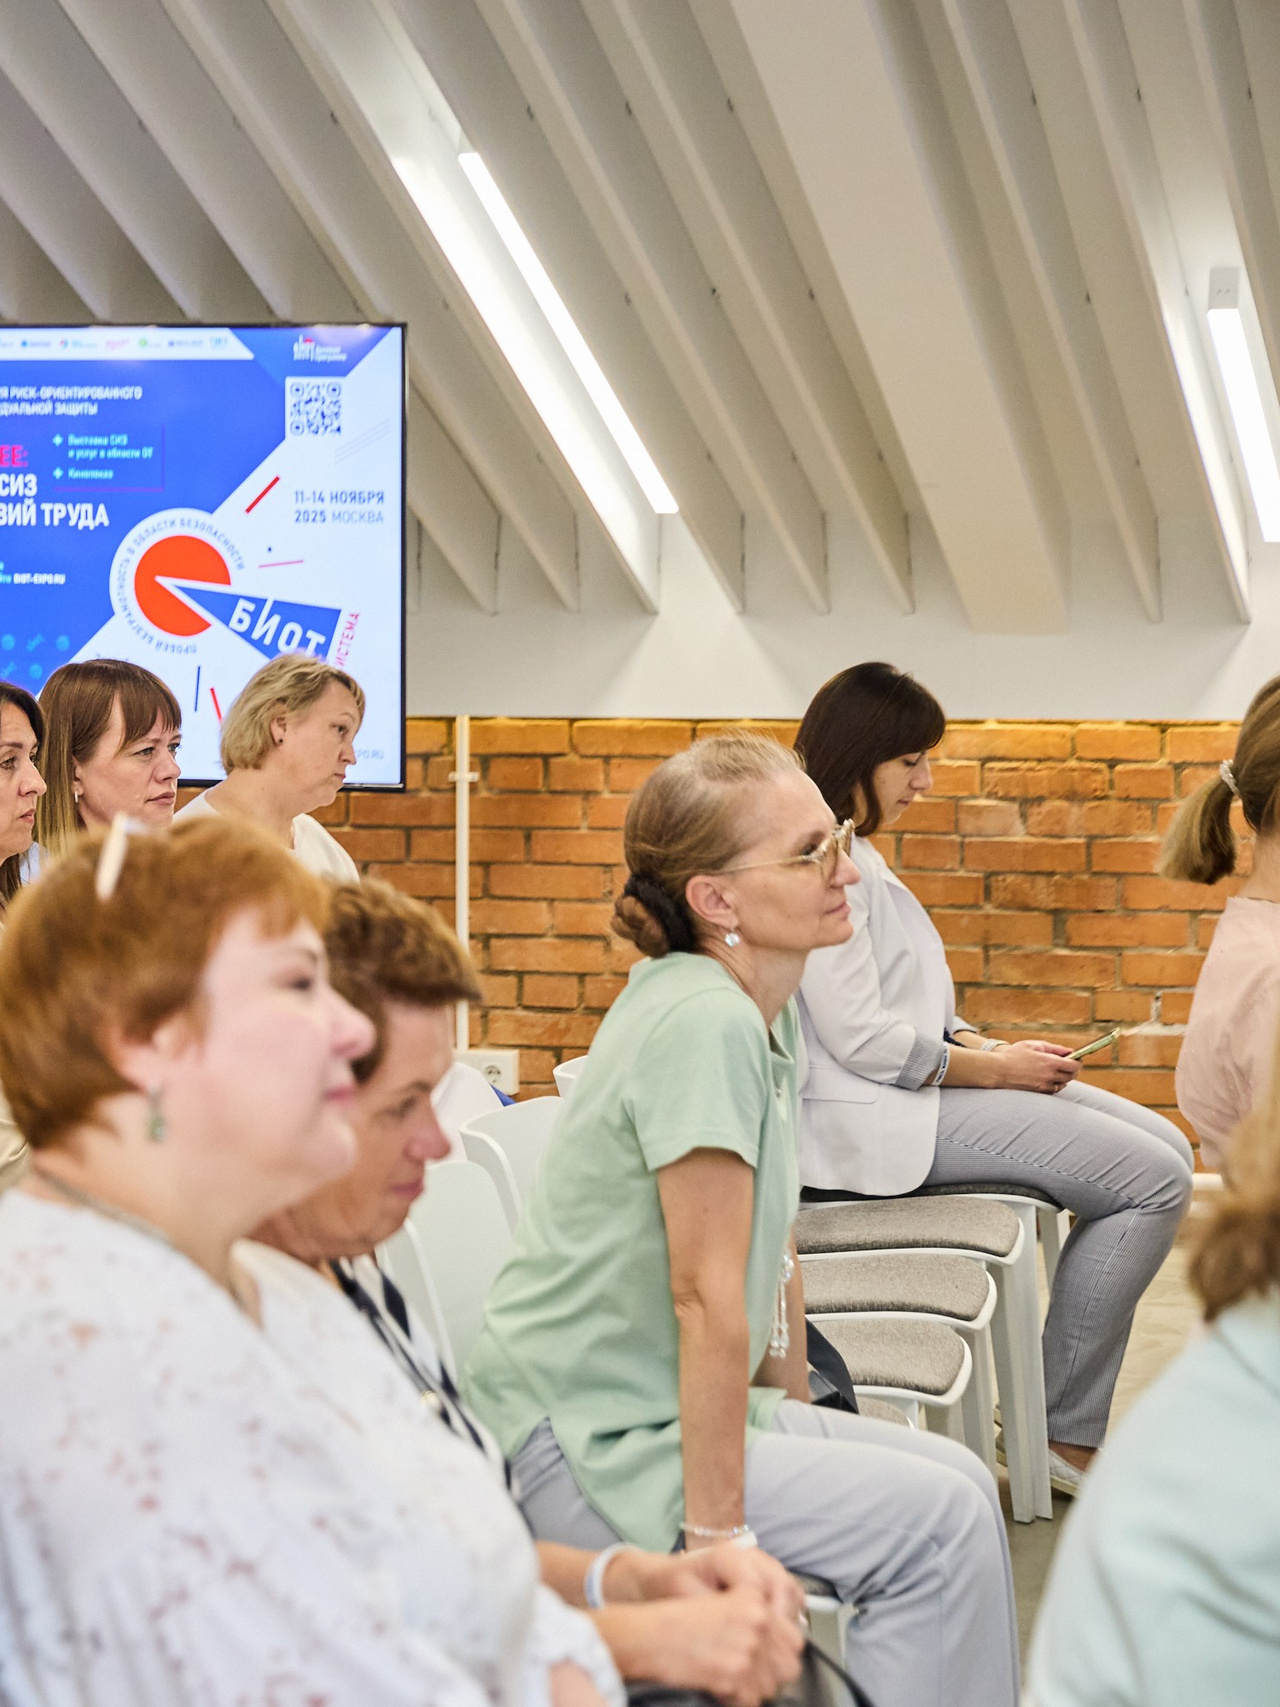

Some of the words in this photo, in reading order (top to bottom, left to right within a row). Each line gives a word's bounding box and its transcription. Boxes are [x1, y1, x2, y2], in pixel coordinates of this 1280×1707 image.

[54, 402, 98, 416] ЗАЩИТЫ
[294, 489, 326, 504] 11-14
[329, 490, 385, 504] НОЯБРЯ
[40, 503, 110, 531] ТРУДА
[293, 510, 327, 524] 2025
[330, 511, 384, 524] МОСКВА
[228, 597, 327, 658] БИОТ
[334, 612, 361, 667] ИСТЕМА
